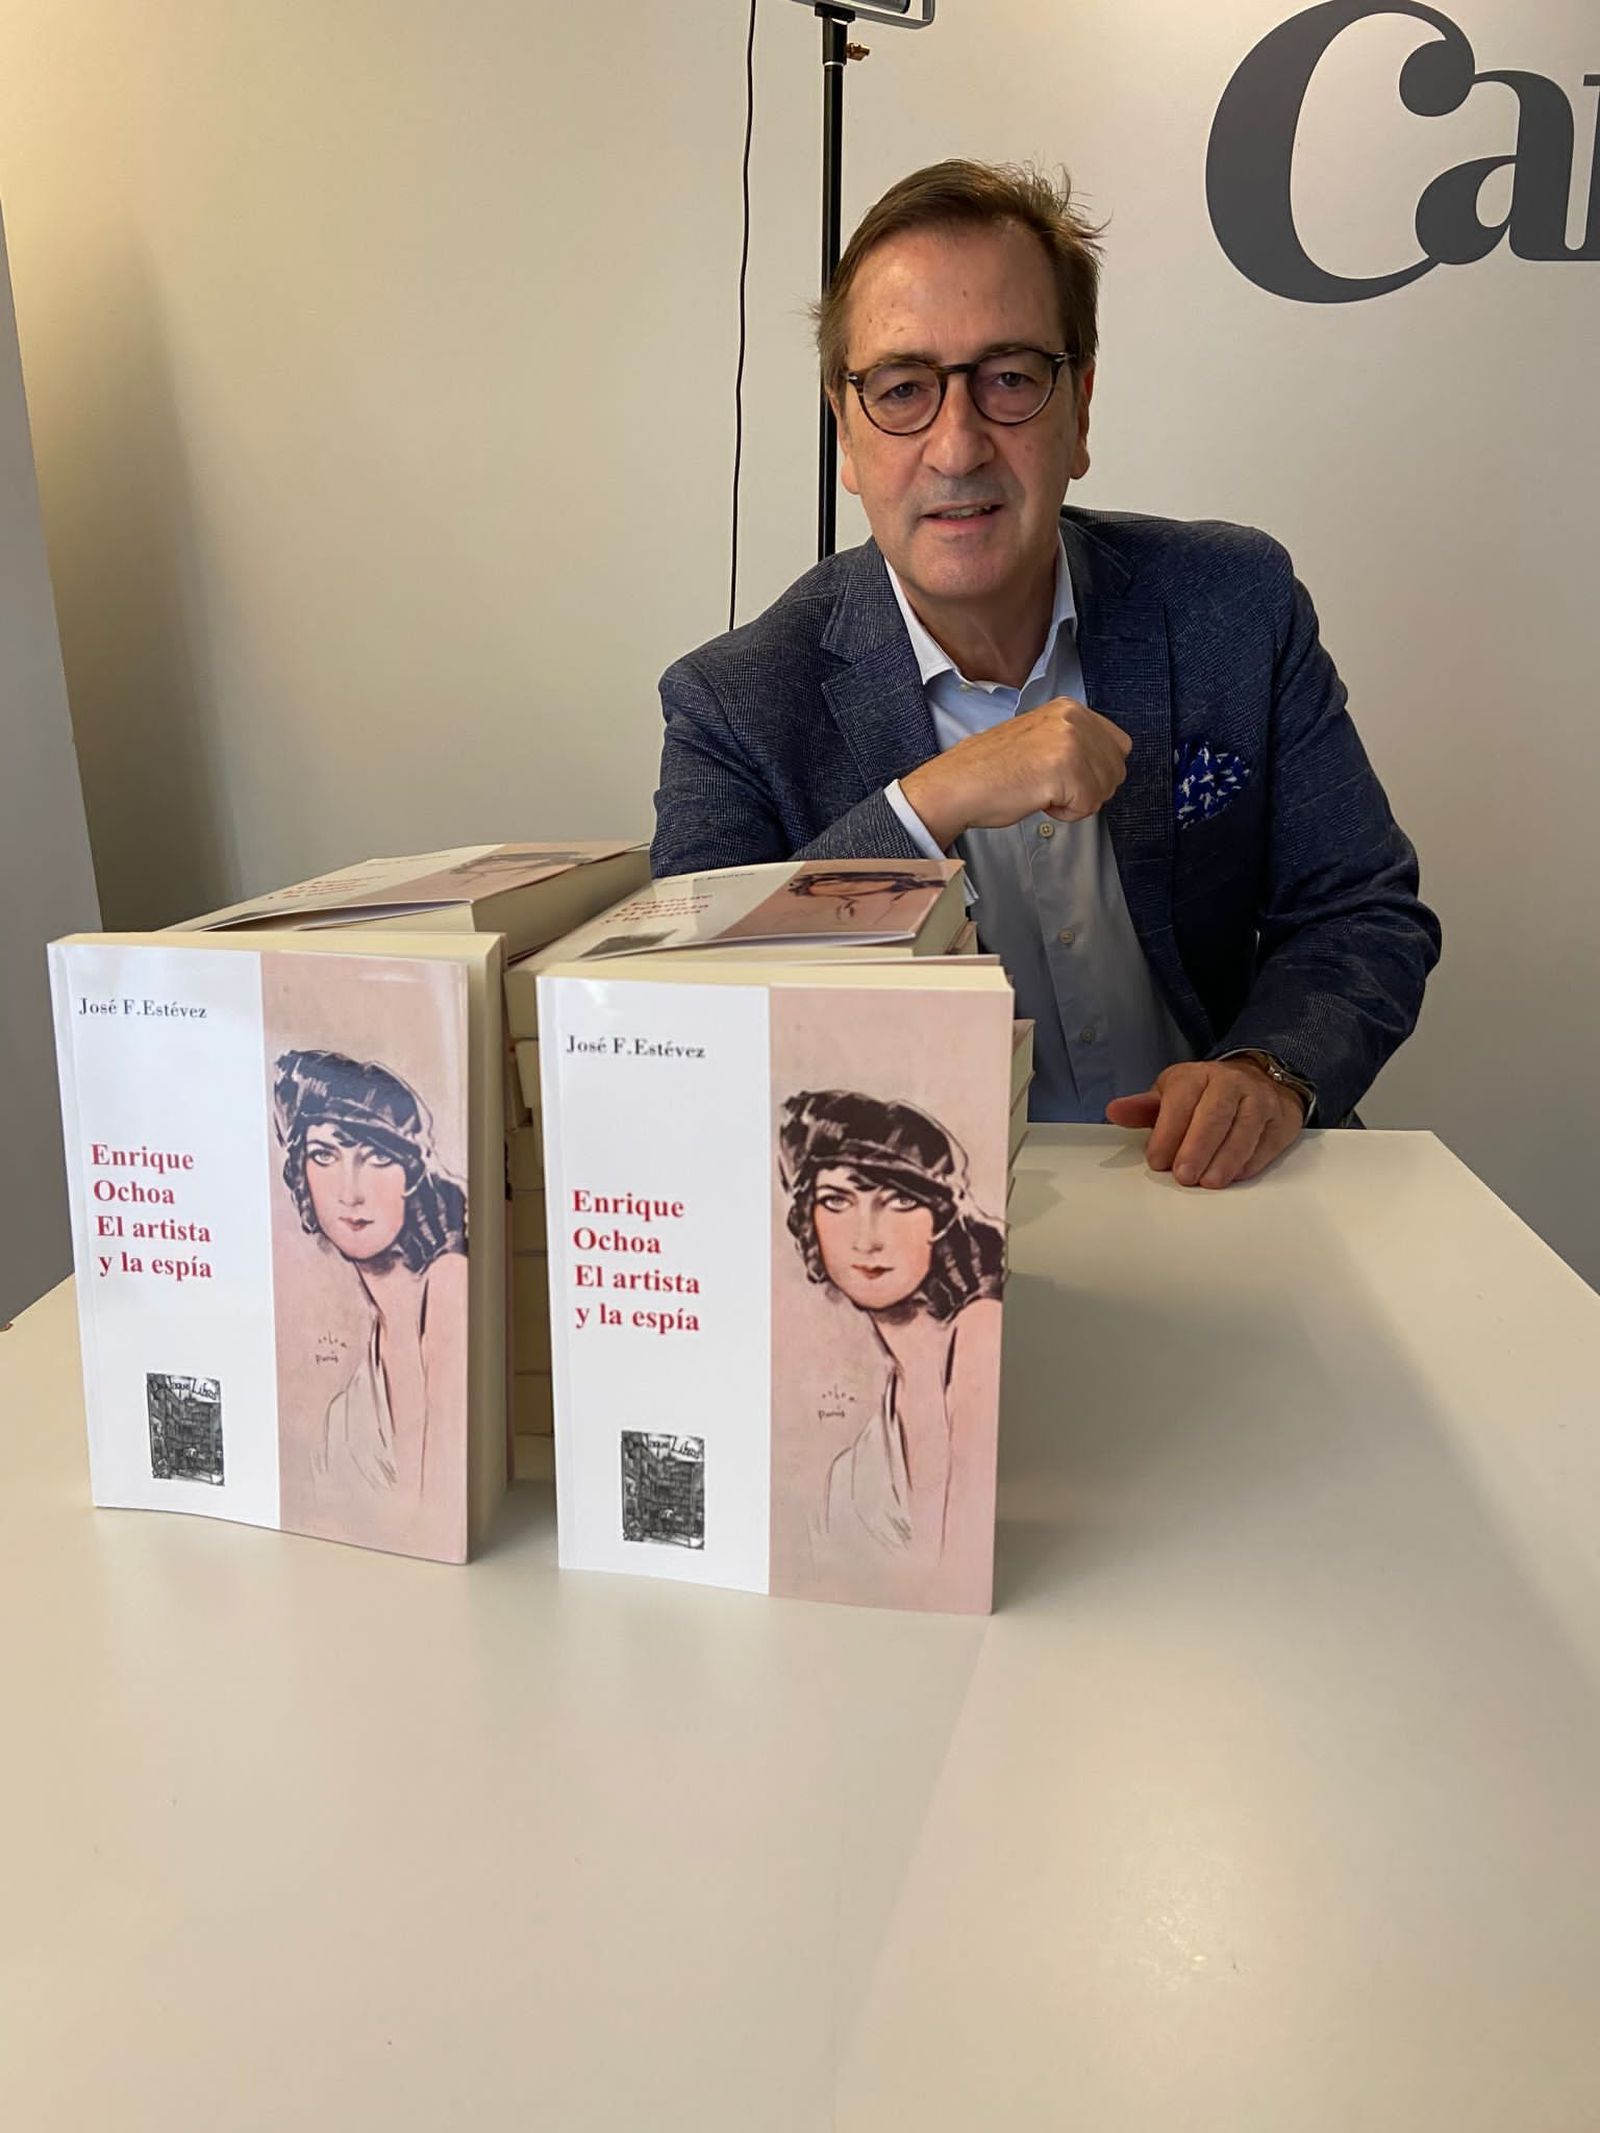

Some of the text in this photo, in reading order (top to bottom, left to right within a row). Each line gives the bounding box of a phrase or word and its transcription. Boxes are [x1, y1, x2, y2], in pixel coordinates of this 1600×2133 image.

[78, 997, 117, 1016] José
[566, 1034, 607, 1053] José
[91, 1143, 194, 1174] Enrique
[93, 1179, 175, 1204] Ochoa
[571, 1189, 685, 1222] Enrique
[97, 1215, 211, 1243] El artista
[573, 1226, 662, 1254] Ochoa
[98, 1251, 213, 1282] y la espía
[575, 1264, 700, 1295] El artista
[575, 1303, 700, 1335] y la espía
